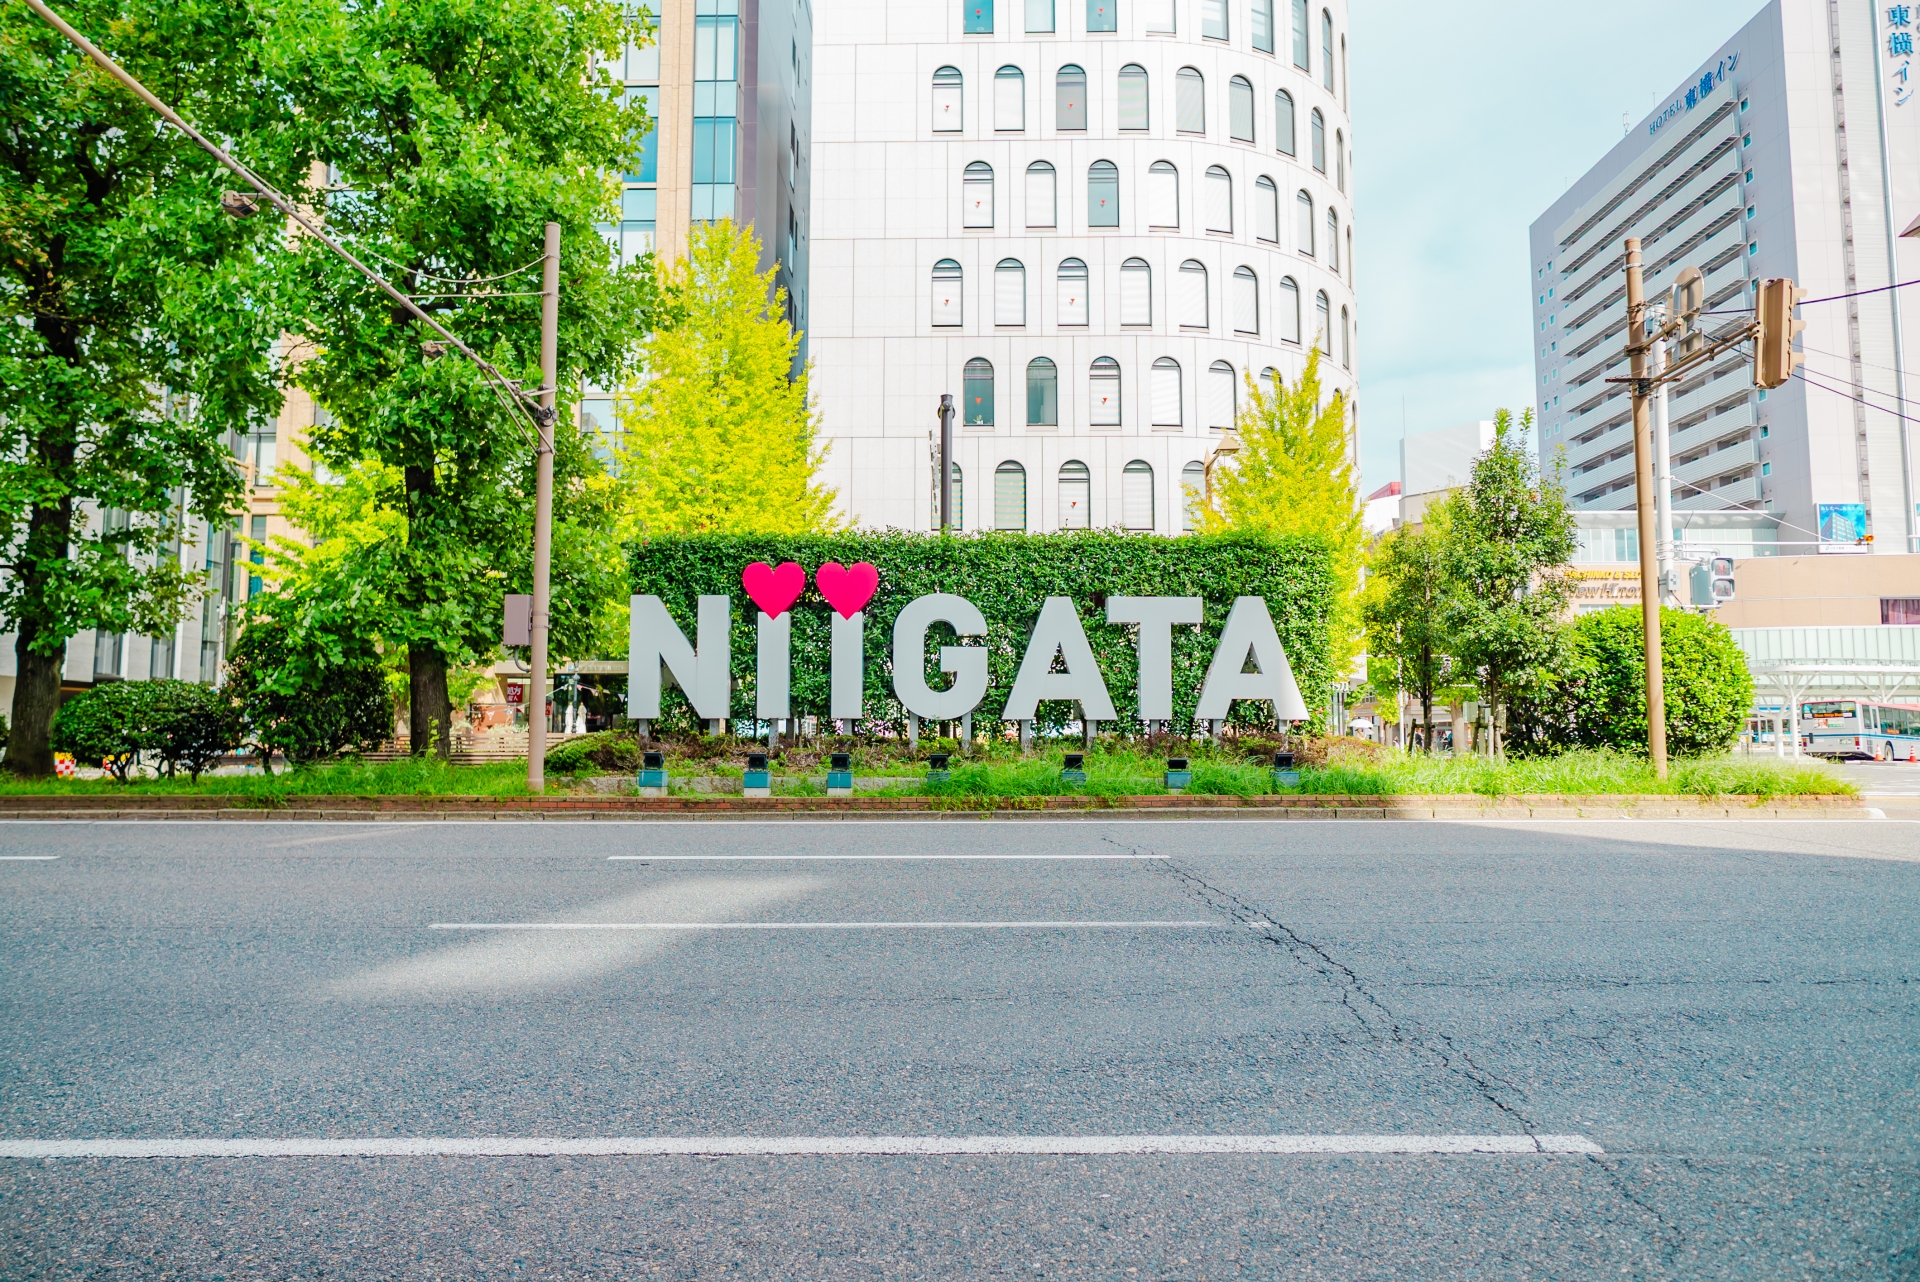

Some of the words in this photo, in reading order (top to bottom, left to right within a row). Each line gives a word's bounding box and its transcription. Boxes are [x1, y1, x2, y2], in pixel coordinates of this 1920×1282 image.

[1886, 4, 1914, 107] 東横イン
[1684, 49, 1741, 114] 東横イン
[1649, 100, 1683, 136] HOTEL
[1623, 570, 1641, 579] SLO
